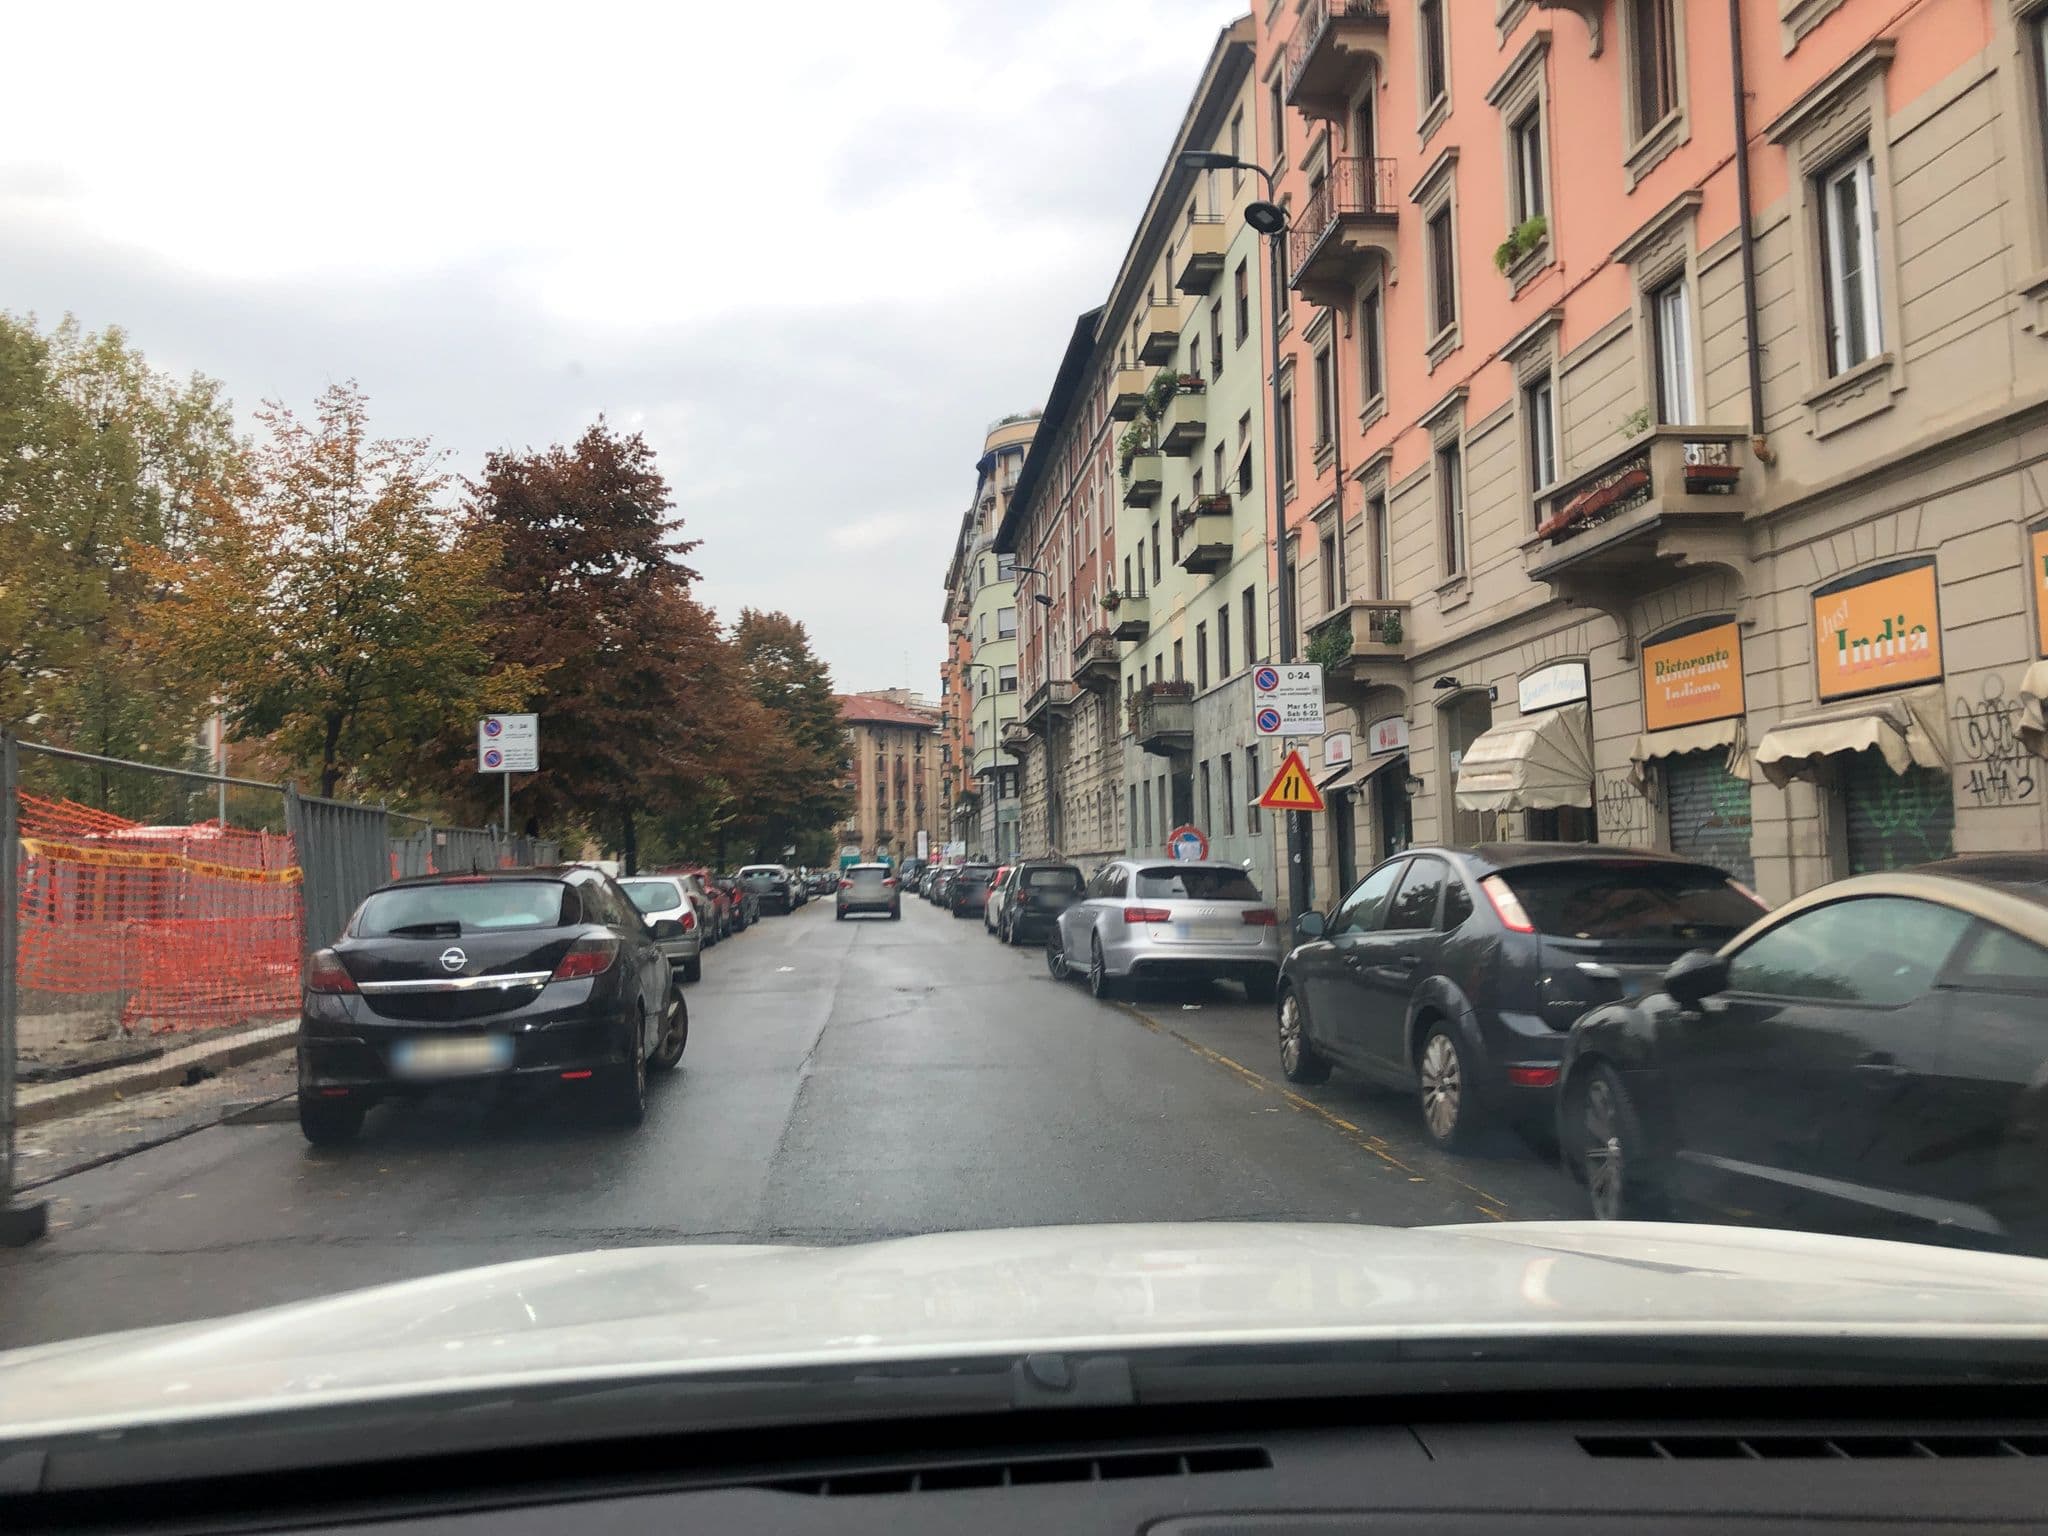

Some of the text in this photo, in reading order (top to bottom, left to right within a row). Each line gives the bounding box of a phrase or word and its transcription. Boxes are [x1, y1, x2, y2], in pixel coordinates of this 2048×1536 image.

[1834, 613, 1931, 672] India
[1287, 671, 1310, 680] 0-24
[1655, 646, 1730, 685] Ristorante
